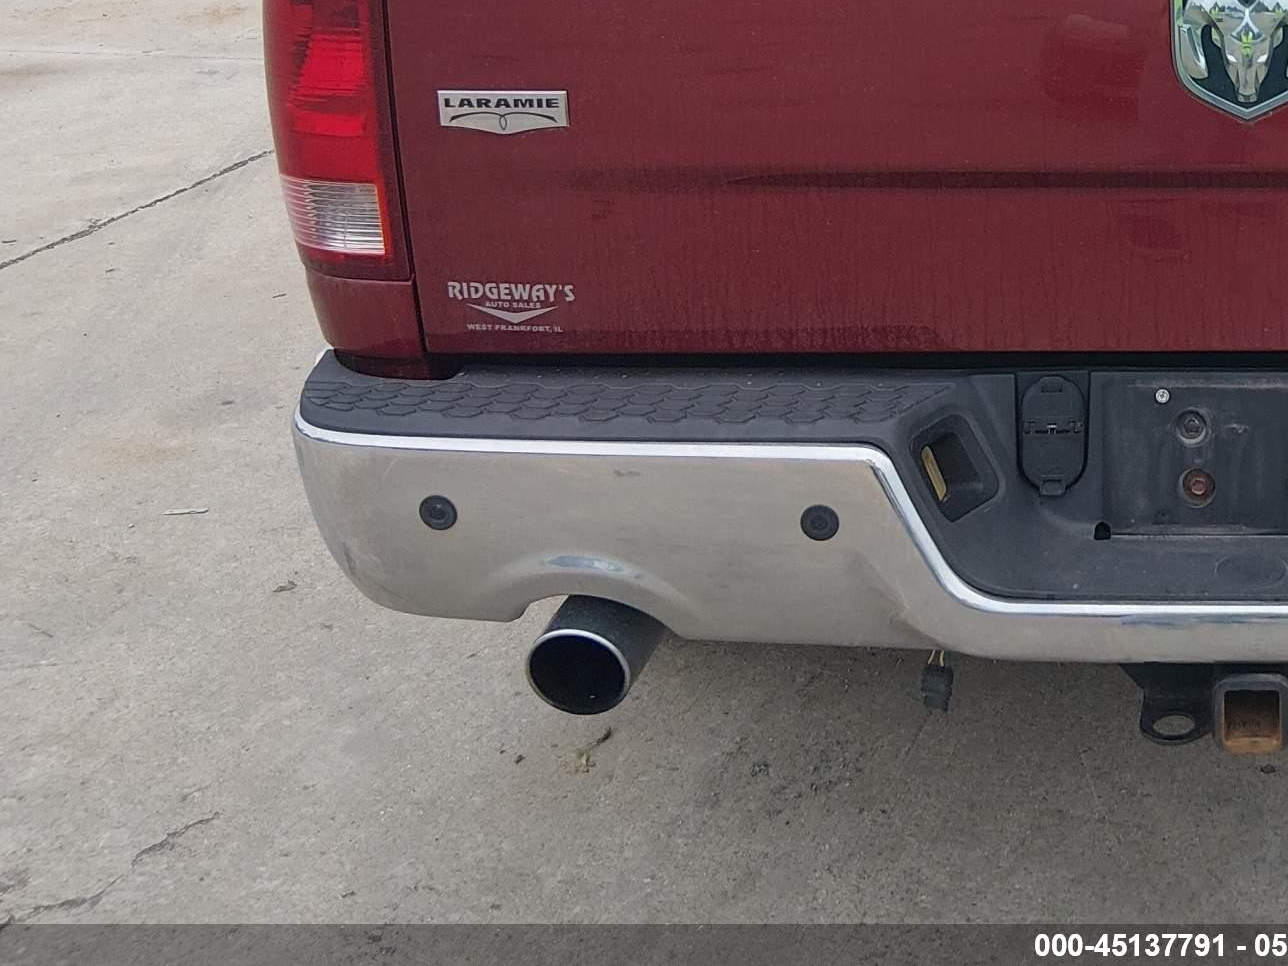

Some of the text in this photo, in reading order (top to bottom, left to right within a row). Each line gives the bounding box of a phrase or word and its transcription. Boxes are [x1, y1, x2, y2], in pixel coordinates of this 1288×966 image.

[444, 97, 560, 108] LARAMIE
[447, 281, 576, 302] RIDGEWAY'S
[466, 323, 564, 333] WEST FRANKFORT, IL
